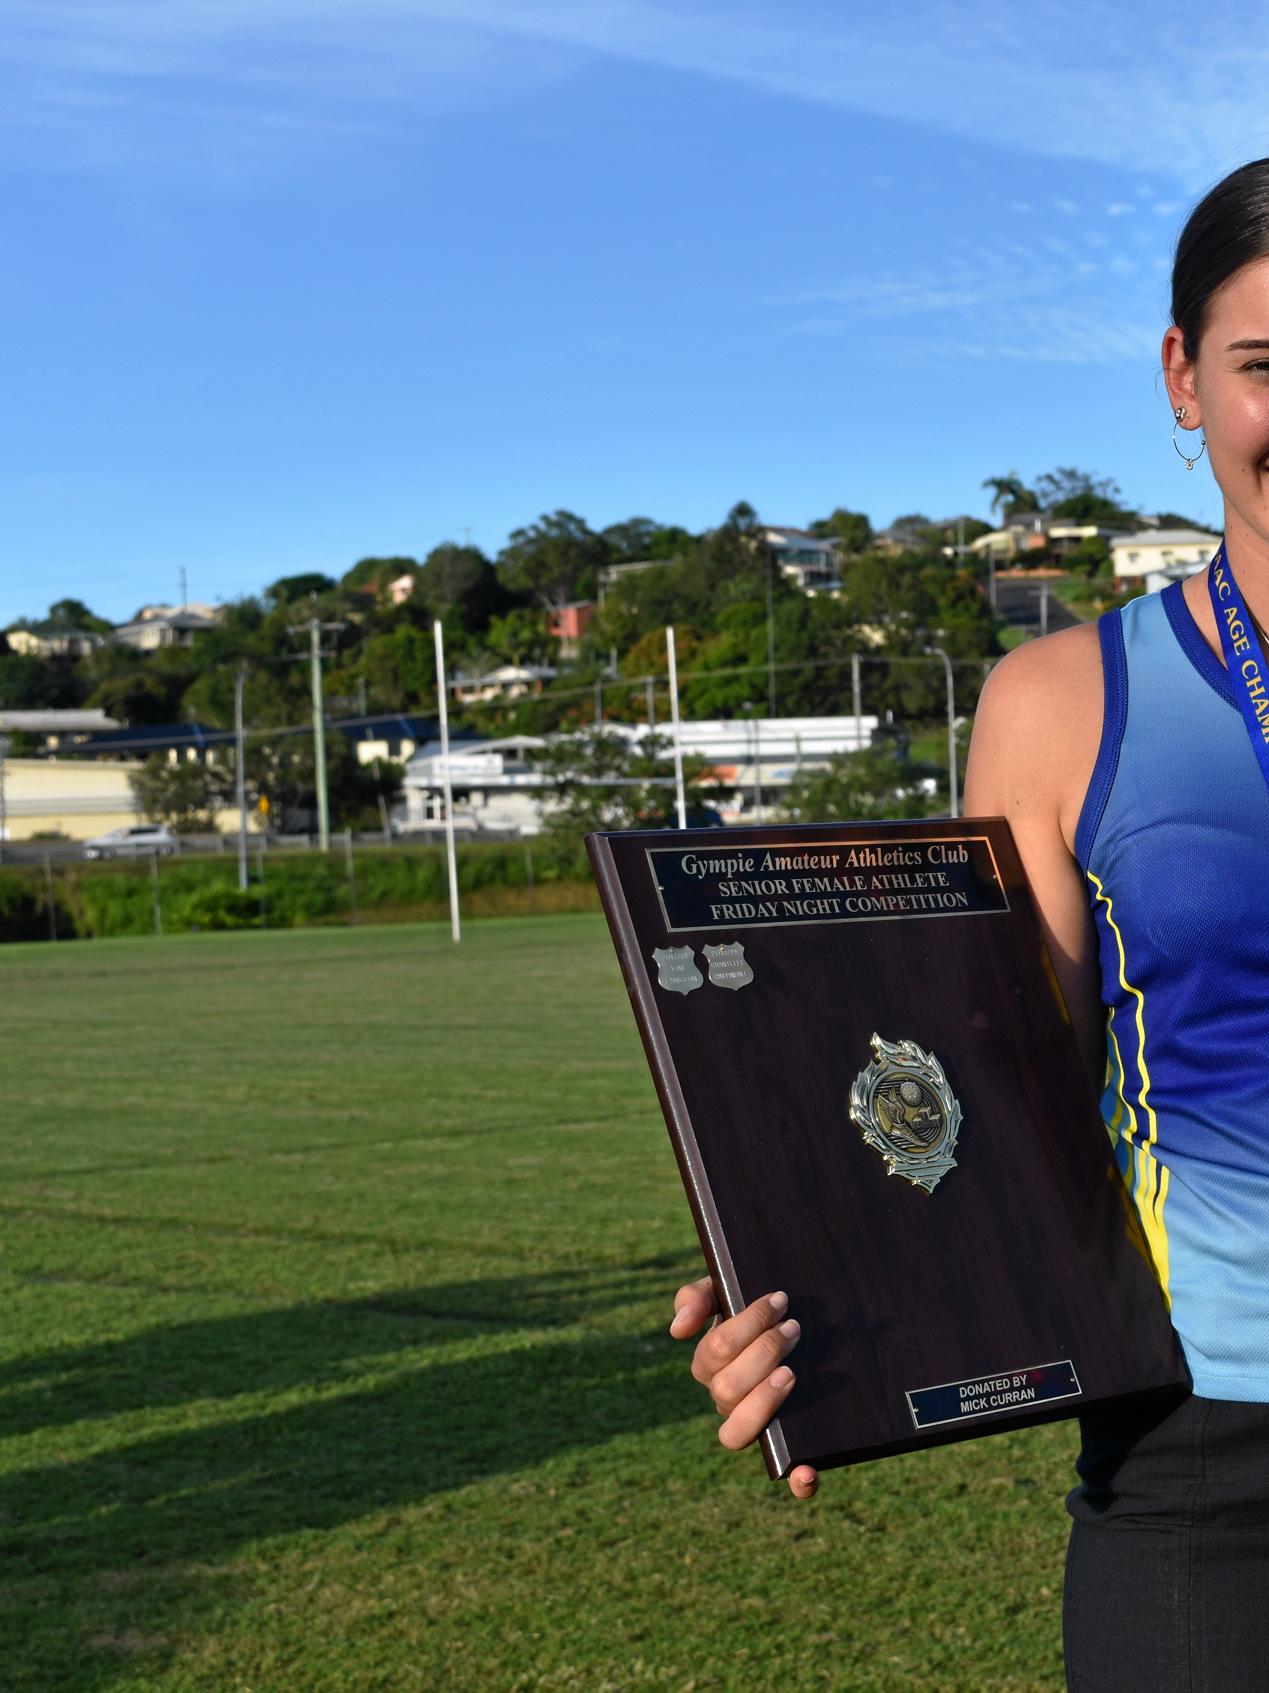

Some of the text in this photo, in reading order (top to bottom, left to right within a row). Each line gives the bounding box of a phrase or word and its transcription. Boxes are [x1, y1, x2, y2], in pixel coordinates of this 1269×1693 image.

[1224, 607, 1250, 656] AGE
[681, 844, 969, 879] Gympie Amateur Athletics Club
[718, 871, 950, 898] SENIOR FEMALE ATHLETE
[710, 892, 969, 920] FRIDAY NIGHT COMPETITION
[959, 1374, 1028, 1398] DONATED BY
[960, 1387, 1036, 1413] MICK CURRAN
